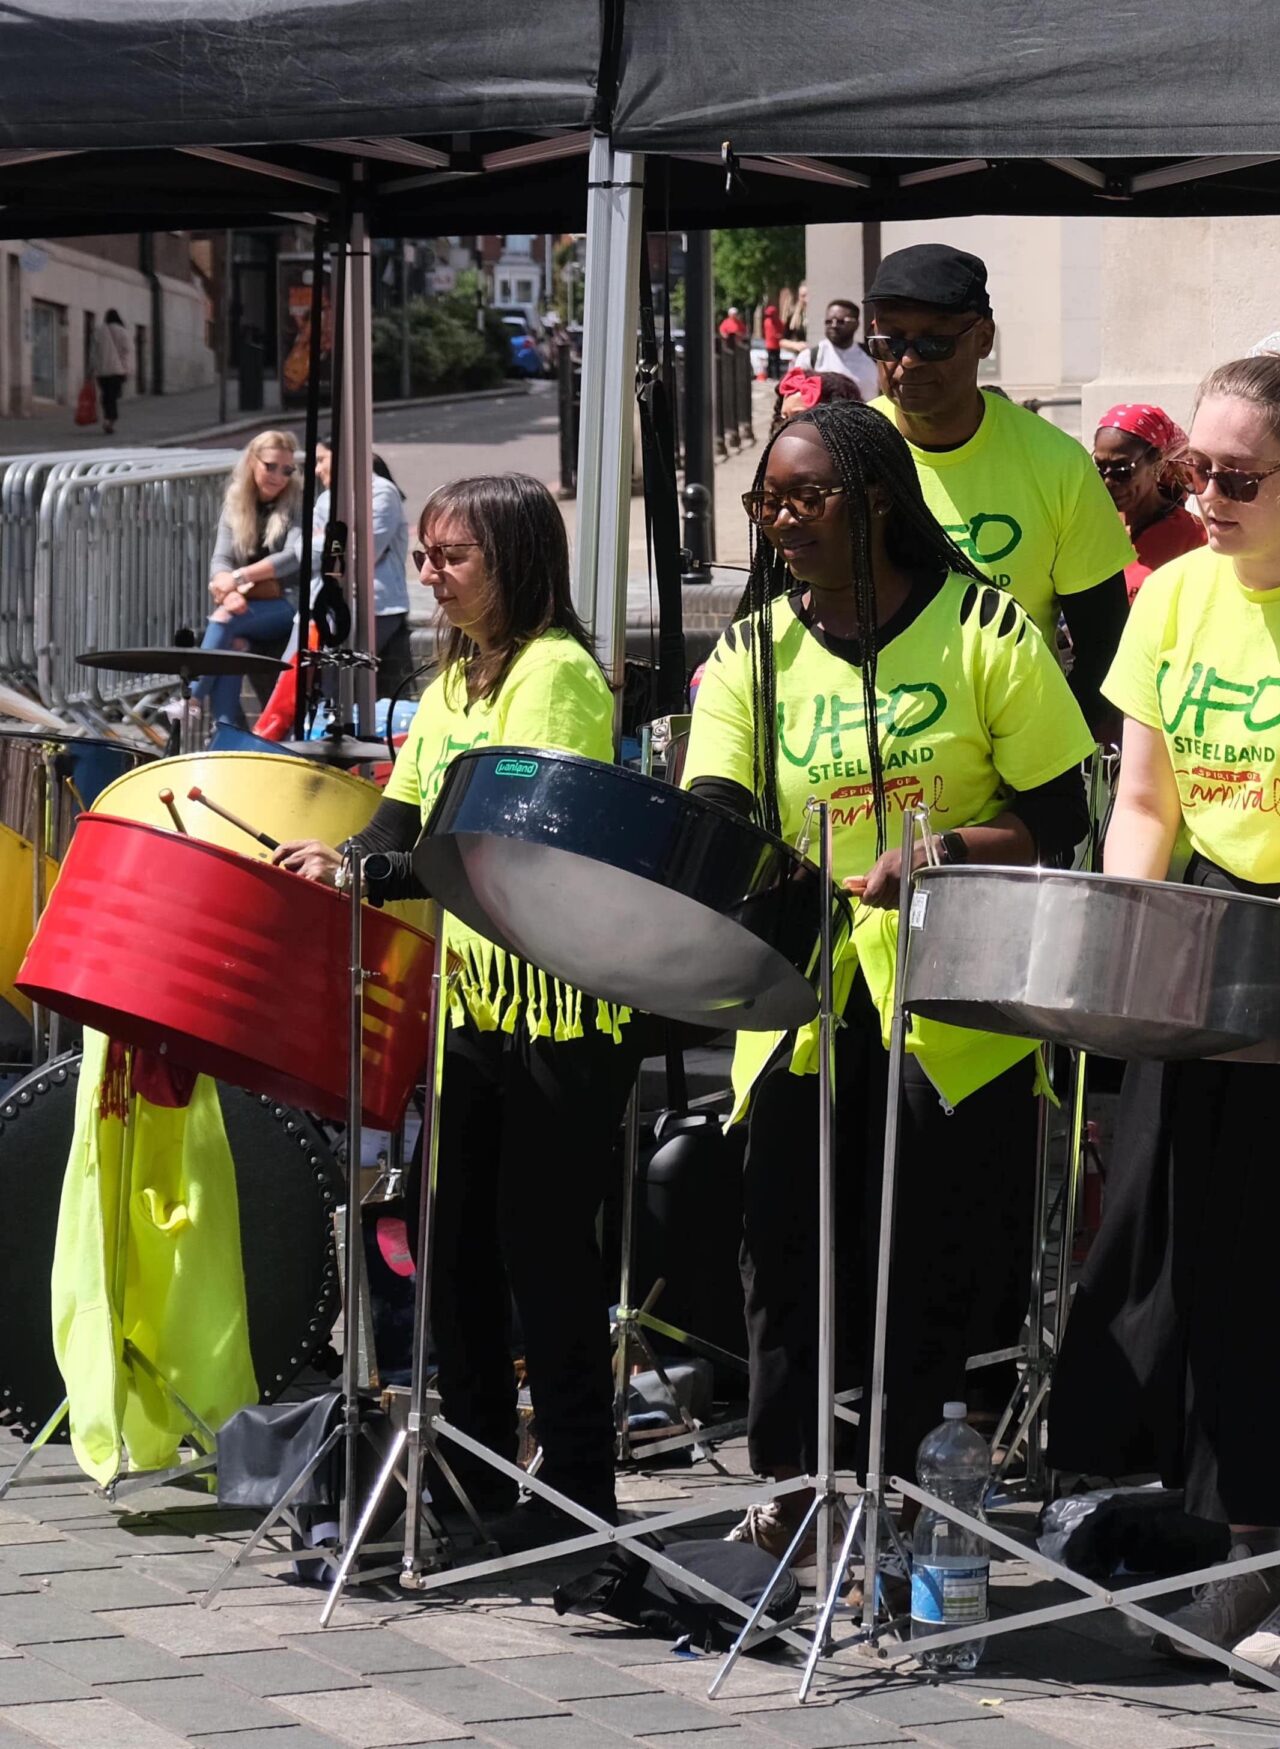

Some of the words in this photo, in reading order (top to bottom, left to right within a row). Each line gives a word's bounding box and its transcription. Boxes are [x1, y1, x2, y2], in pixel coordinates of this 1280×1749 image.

[777, 682, 948, 767] UFO
[808, 746, 935, 784] STEELAND
[1174, 736, 1276, 763] STEELBAND
